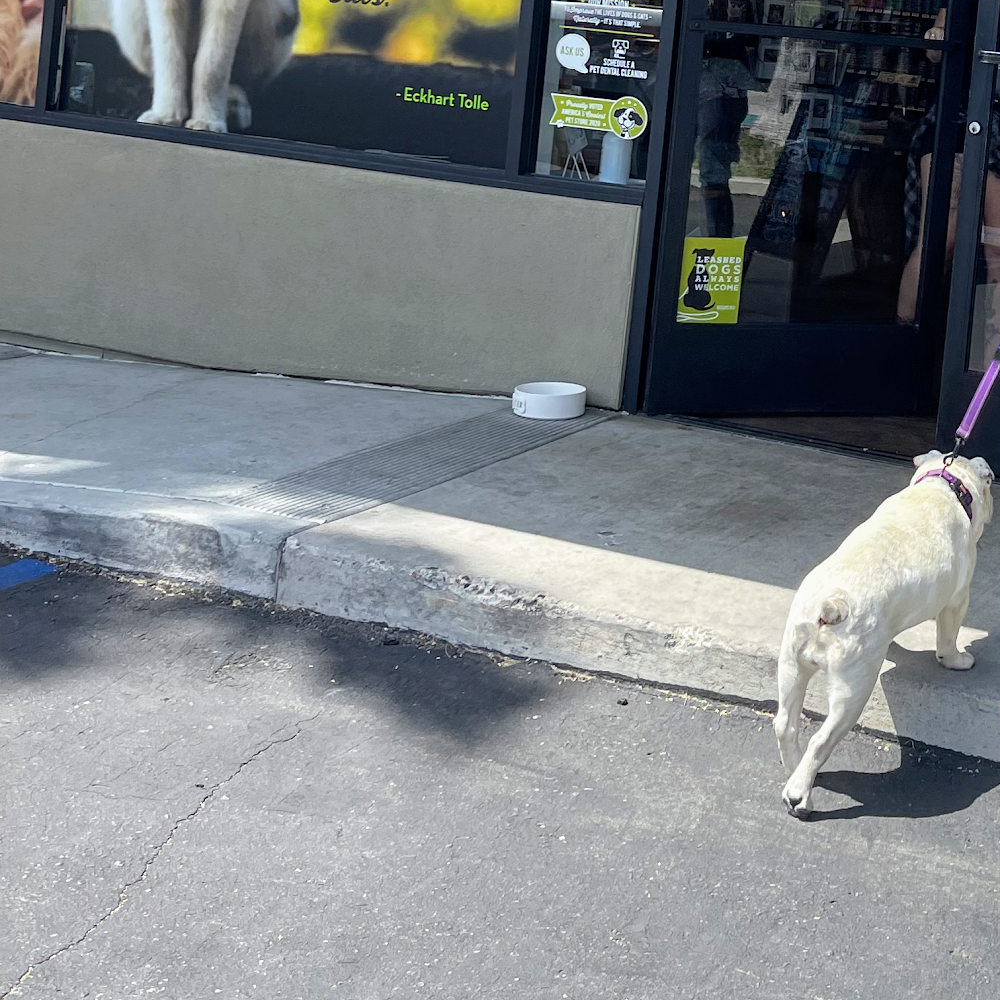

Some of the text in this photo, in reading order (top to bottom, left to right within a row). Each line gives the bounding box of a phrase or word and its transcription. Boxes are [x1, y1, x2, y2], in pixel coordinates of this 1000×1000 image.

[602, 9, 615, 17] LIVES
[561, 46, 584, 57] ASK US
[603, 57, 631, 69] SCHEDULE
[589, 65, 648, 79] PET DENTAL CLEANING
[457, 93, 490, 111] Tolle
[697, 256, 742, 264] LEASHED
[696, 264, 741, 275] DOGS
[694, 275, 740, 283] ALWAYS
[694, 284, 739, 292] WELCOME
